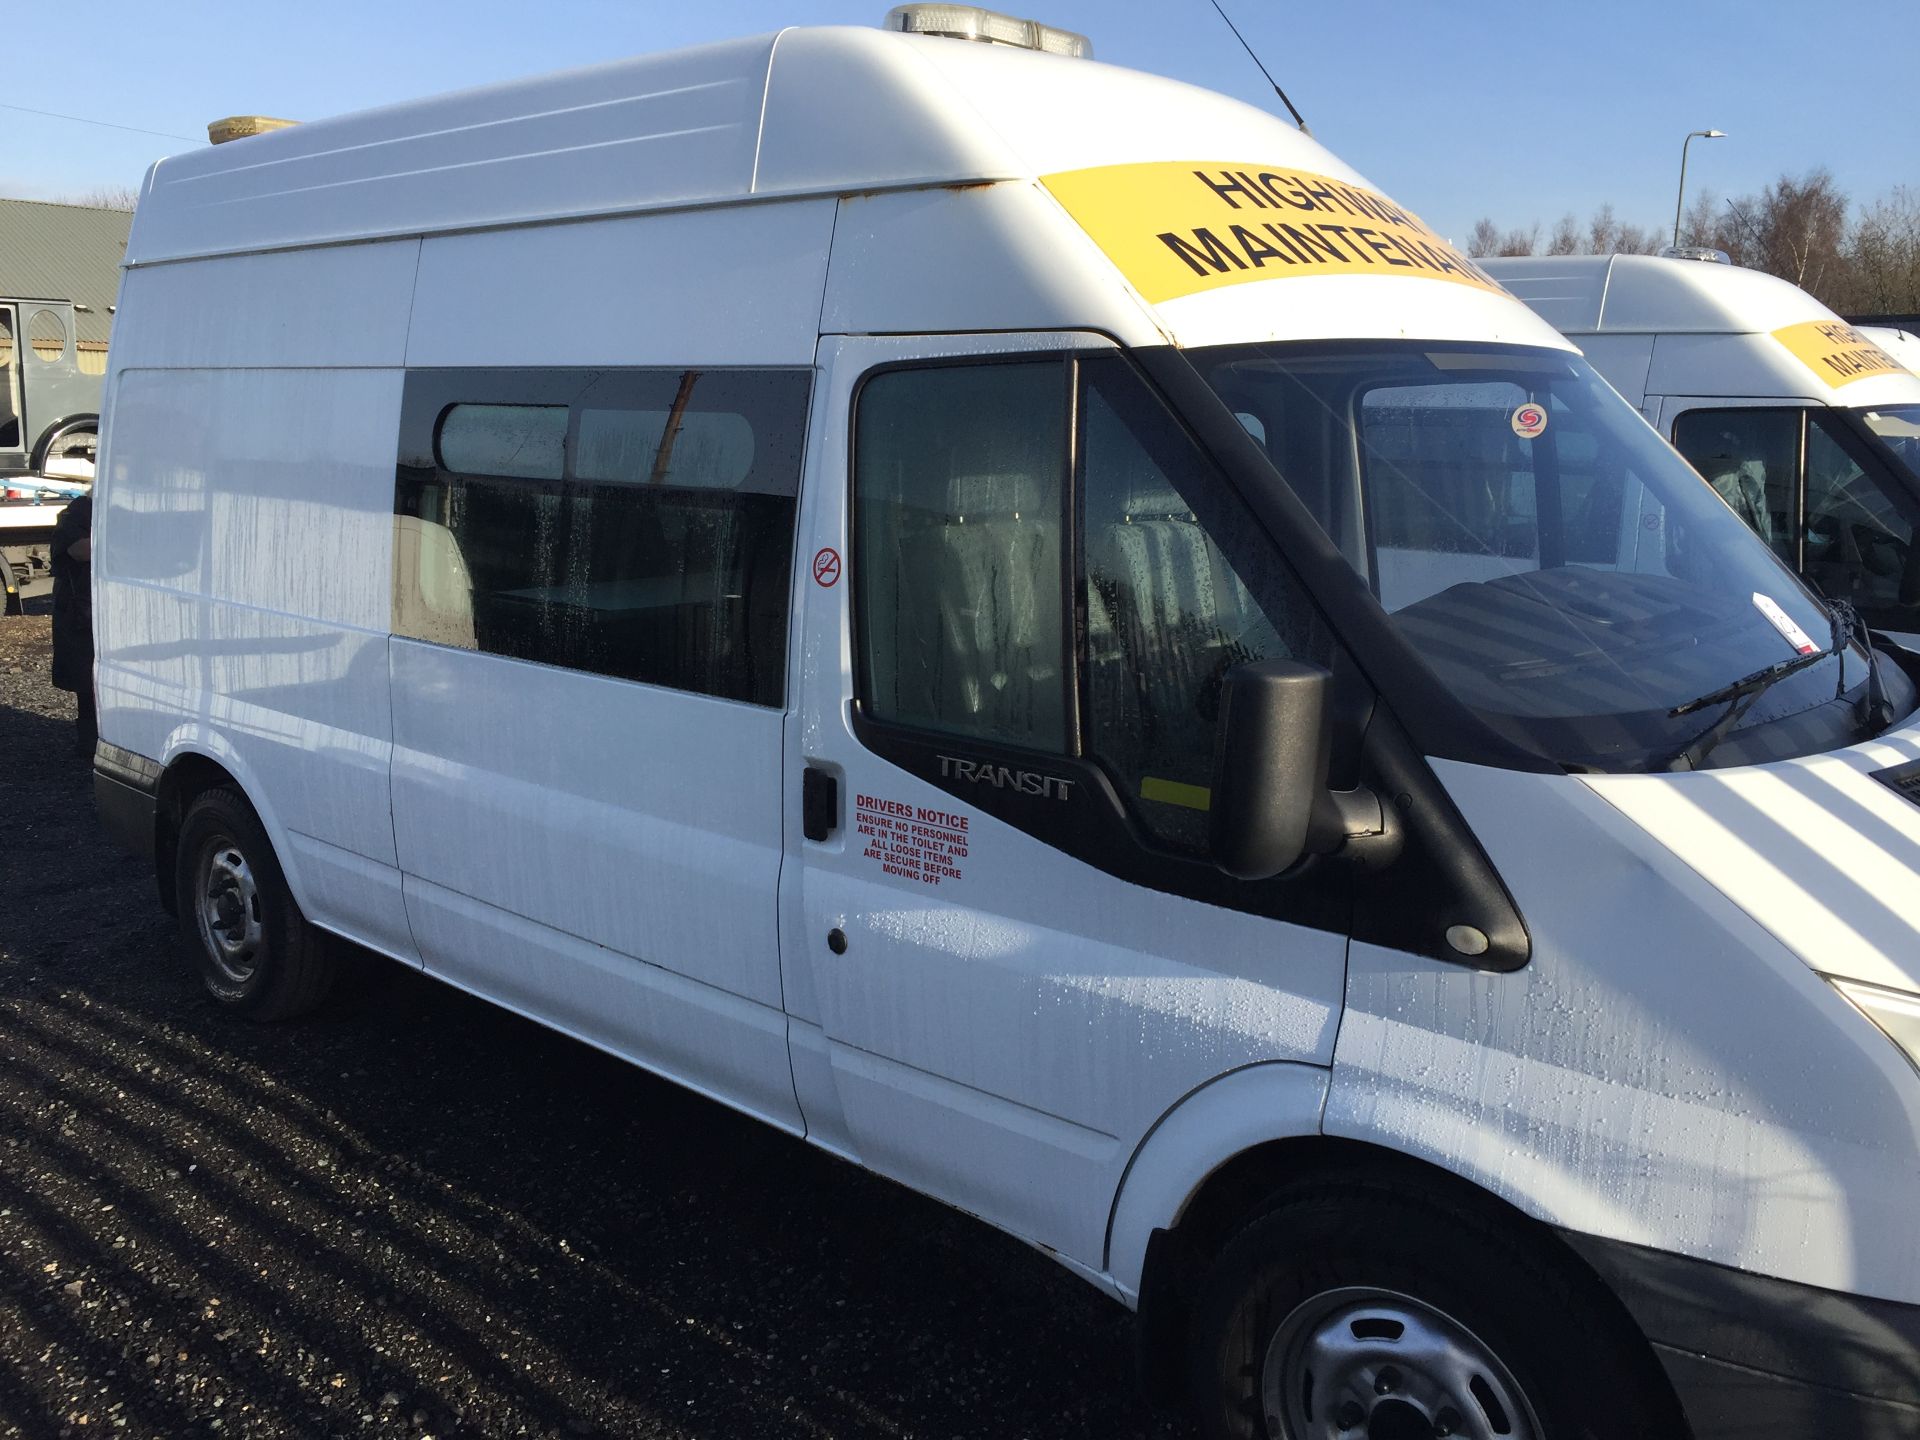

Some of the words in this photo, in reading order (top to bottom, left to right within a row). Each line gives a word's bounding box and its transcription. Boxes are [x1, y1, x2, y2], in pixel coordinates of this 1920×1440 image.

[936, 755, 1075, 800] TRANSIT
[857, 795, 912, 817] DRIVERS
[917, 808, 968, 830] NOTICE
[857, 813, 892, 828] ENSURE
[895, 822, 908, 832] NO
[911, 825, 968, 846] PERSONNEL
[857, 825, 875, 836] ARE
[878, 829, 887, 839] IN
[890, 832, 908, 843] THE
[911, 836, 944, 852] TOILET
[947, 845, 968, 857] AND
[863, 848, 881, 860] ARE
[884, 853, 920, 869] SECURE
[924, 862, 961, 879] BEFORE
[871, 839, 887, 850] ALL
[890, 843, 920, 858] LOOSE
[923, 851, 953, 865] ITEMS
[883, 864, 919, 880] MOVING
[922, 874, 940, 885] OFF
